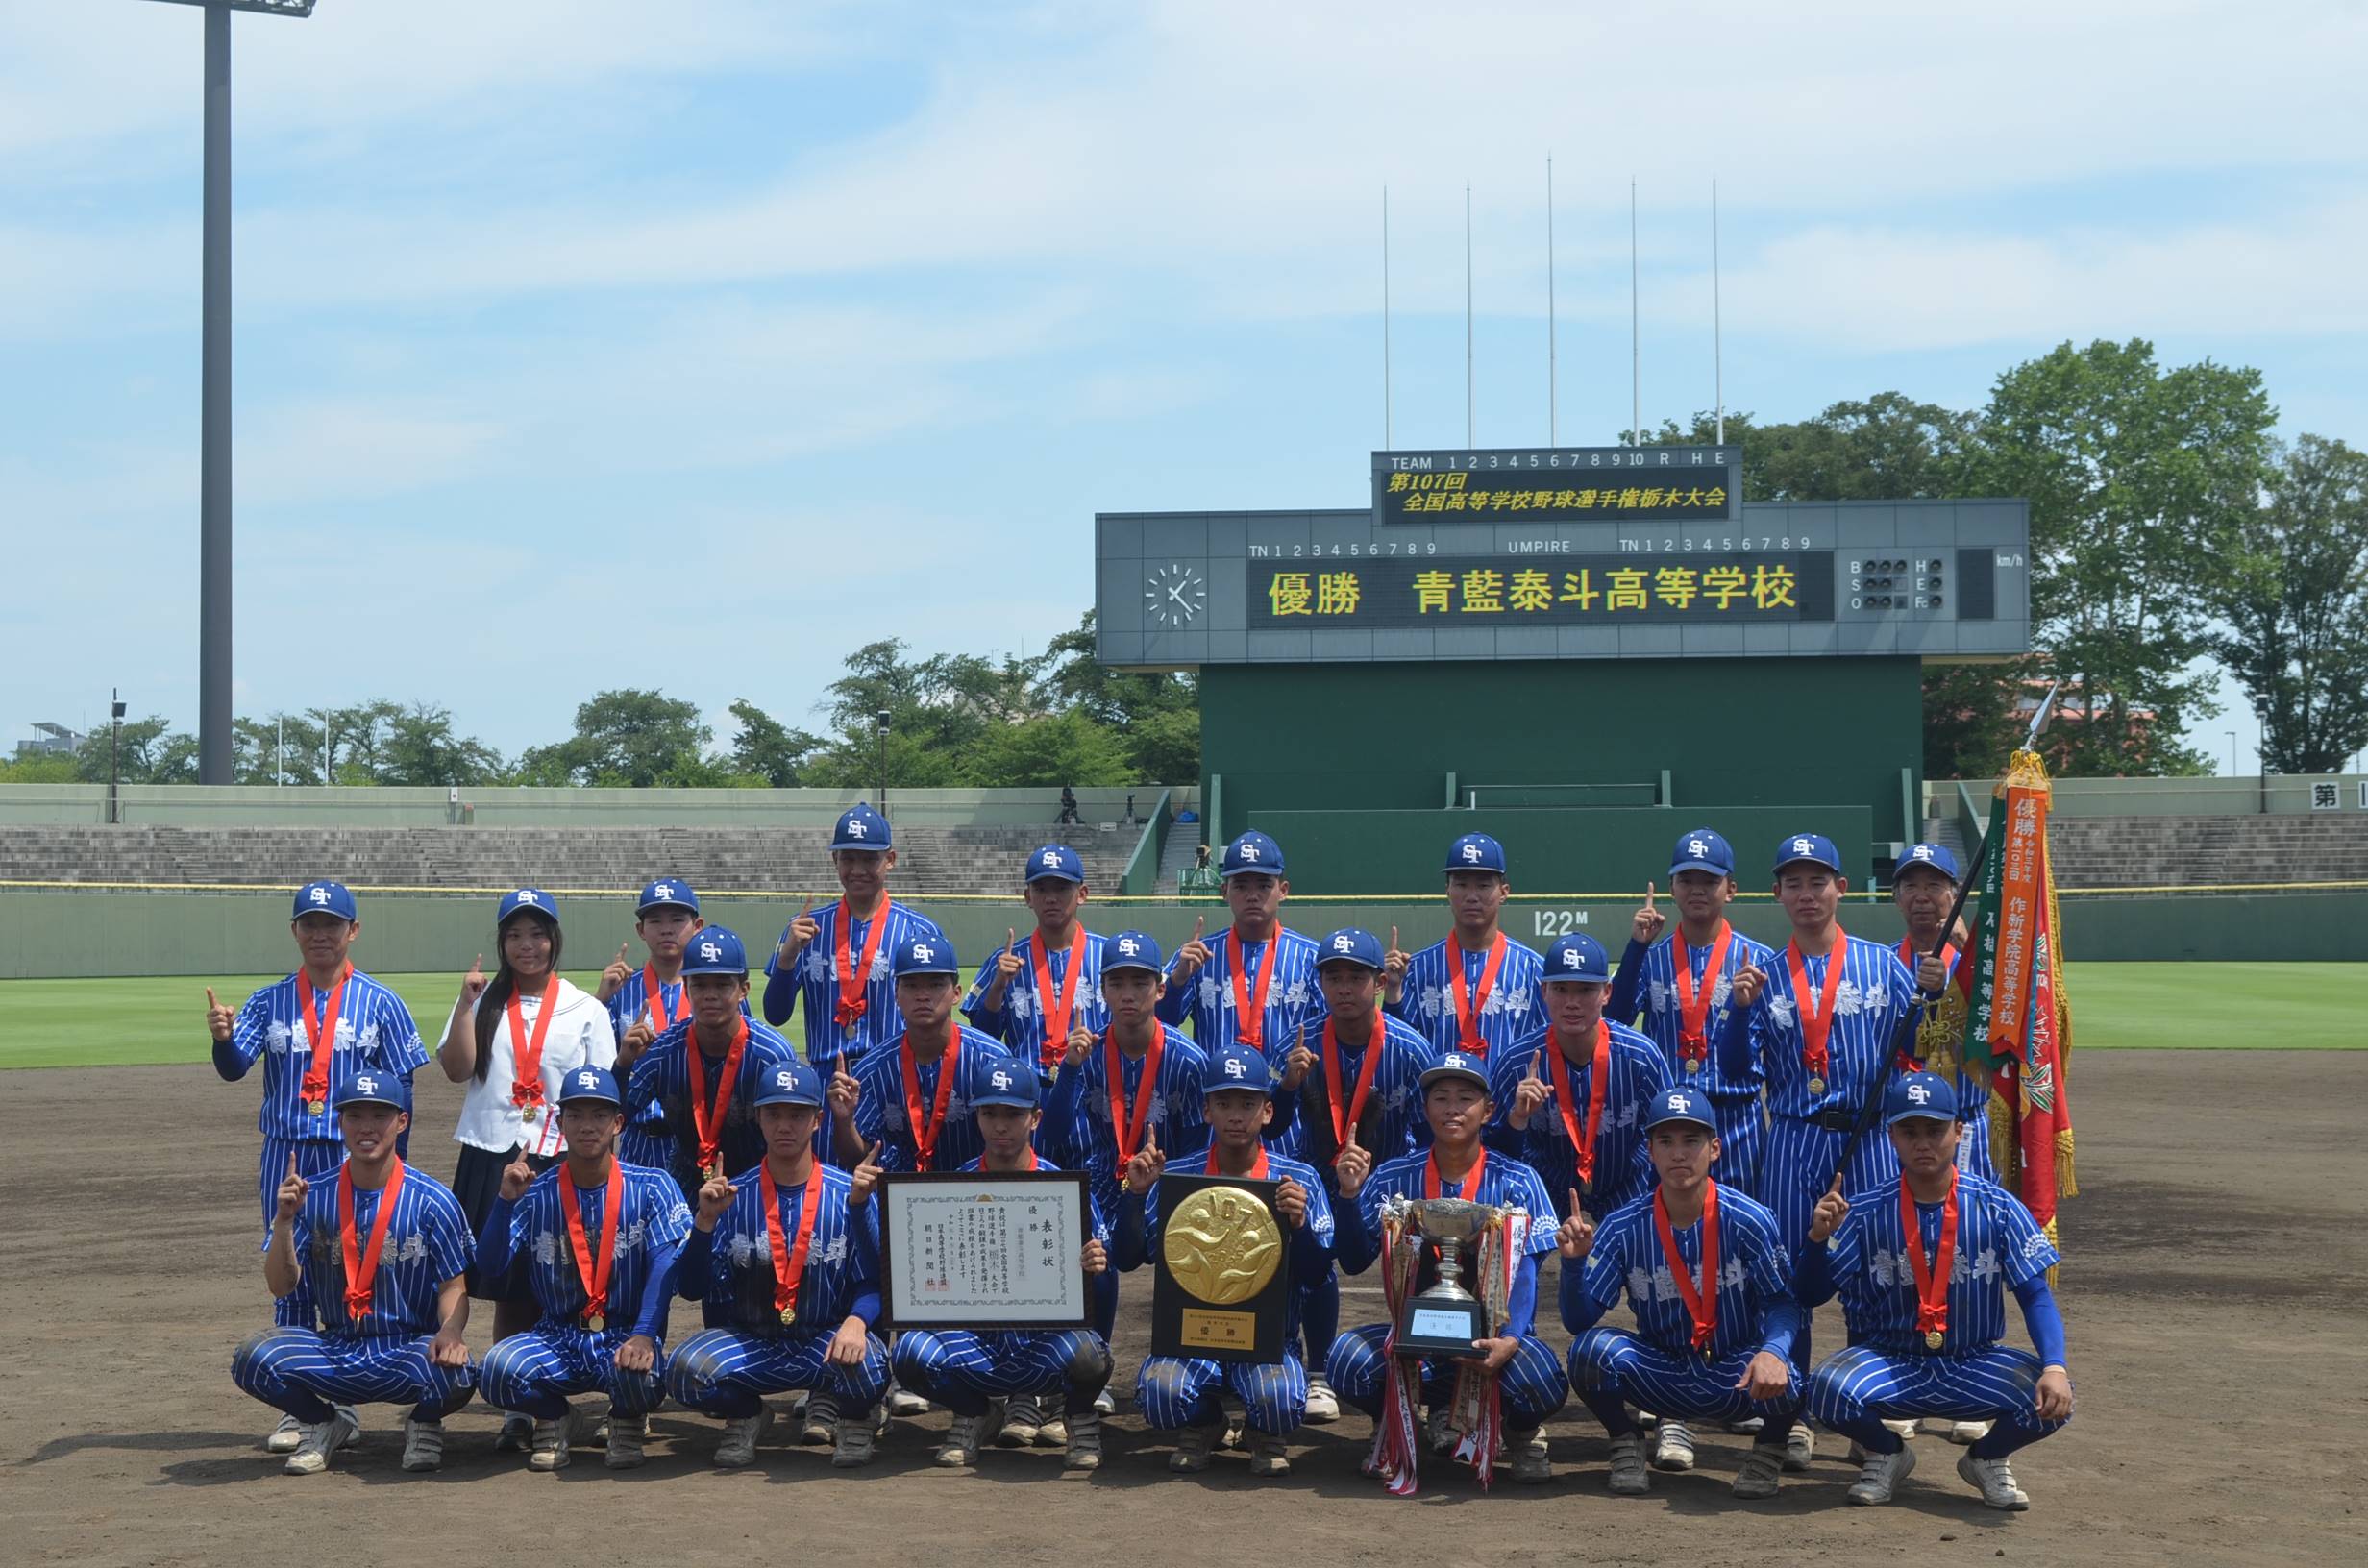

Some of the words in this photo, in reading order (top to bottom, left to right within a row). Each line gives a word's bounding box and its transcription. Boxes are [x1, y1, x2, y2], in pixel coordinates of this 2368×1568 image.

[1392, 457, 1432, 470] TEAM
[1449, 457, 1456, 469] 1
[1469, 456, 1478, 468] 2
[1490, 456, 1498, 468] 3
[1509, 455, 1518, 467] 4
[1530, 455, 1539, 467] 5
[1550, 455, 1559, 467] 6
[1570, 454, 1580, 467] 7
[1591, 454, 1600, 466] 8
[1612, 453, 1620, 466] 9
[1630, 453, 1644, 466] 10
[1660, 453, 1669, 465] R
[1692, 453, 1702, 464] H
[1715, 452, 1724, 464] E
[1387, 472, 1468, 492] 第107回
[1403, 487, 1726, 512] 全国高等学校野球選手権栃木大会
[1249, 545, 1268, 557] TN
[1275, 546, 1281, 556] 1
[1294, 545, 1302, 556] 2
[1313, 545, 1321, 556] 3
[1331, 545, 1340, 555] 4
[1350, 544, 1359, 555] 5
[1369, 544, 1378, 555] 6
[1389, 544, 1396, 554] 7
[1408, 543, 1417, 554] 8
[1427, 543, 1436, 554] 9
[1508, 540, 1571, 553] UMPIRE
[1619, 539, 1639, 551] TN
[1646, 540, 1652, 551] 1
[1665, 539, 1673, 551] 2
[1684, 539, 1692, 551] 3
[1703, 539, 1713, 551] 4
[1723, 538, 1731, 550] 5
[1742, 538, 1751, 550] 6
[1762, 538, 1770, 550] 7
[1781, 537, 1790, 550] 8
[1800, 537, 1810, 549] 9
[1851, 561, 1861, 574] B
[1916, 560, 1926, 573] H
[1996, 554, 2023, 568] km/h
[1269, 571, 1361, 616] 優勝
[1412, 565, 1796, 614] 青藍泰斗高等学校
[1852, 579, 1861, 591] S
[1917, 578, 1926, 590] E
[2014, 799, 2037, 836] 優勝
[848, 820, 867, 839] ST
[1241, 844, 1261, 863] ST
[1462, 845, 1483, 864] ST
[1688, 840, 1709, 859] ST
[1793, 839, 1814, 856] ST
[1913, 845, 1934, 861] ST
[1043, 851, 1062, 869] ST
[309, 887, 331, 906] ST
[517, 891, 538, 904] ST
[654, 884, 674, 900] ST
[701, 943, 722, 962] ST
[913, 943, 934, 964] ST
[1119, 938, 1140, 957] ST
[1333, 935, 1355, 954] ST
[1563, 948, 1585, 969] ST
[1999, 896, 2027, 1025] 作新学院高等学校
[1224, 1059, 1246, 1079] ST
[357, 1077, 378, 1095] ST
[579, 1071, 600, 1090] ST
[777, 1071, 799, 1091] ST
[991, 1070, 1012, 1091] ST
[1907, 1084, 1931, 1104] ST
[1668, 1094, 1691, 1114] ST
[1041, 1218, 1054, 1267] 表彰状
